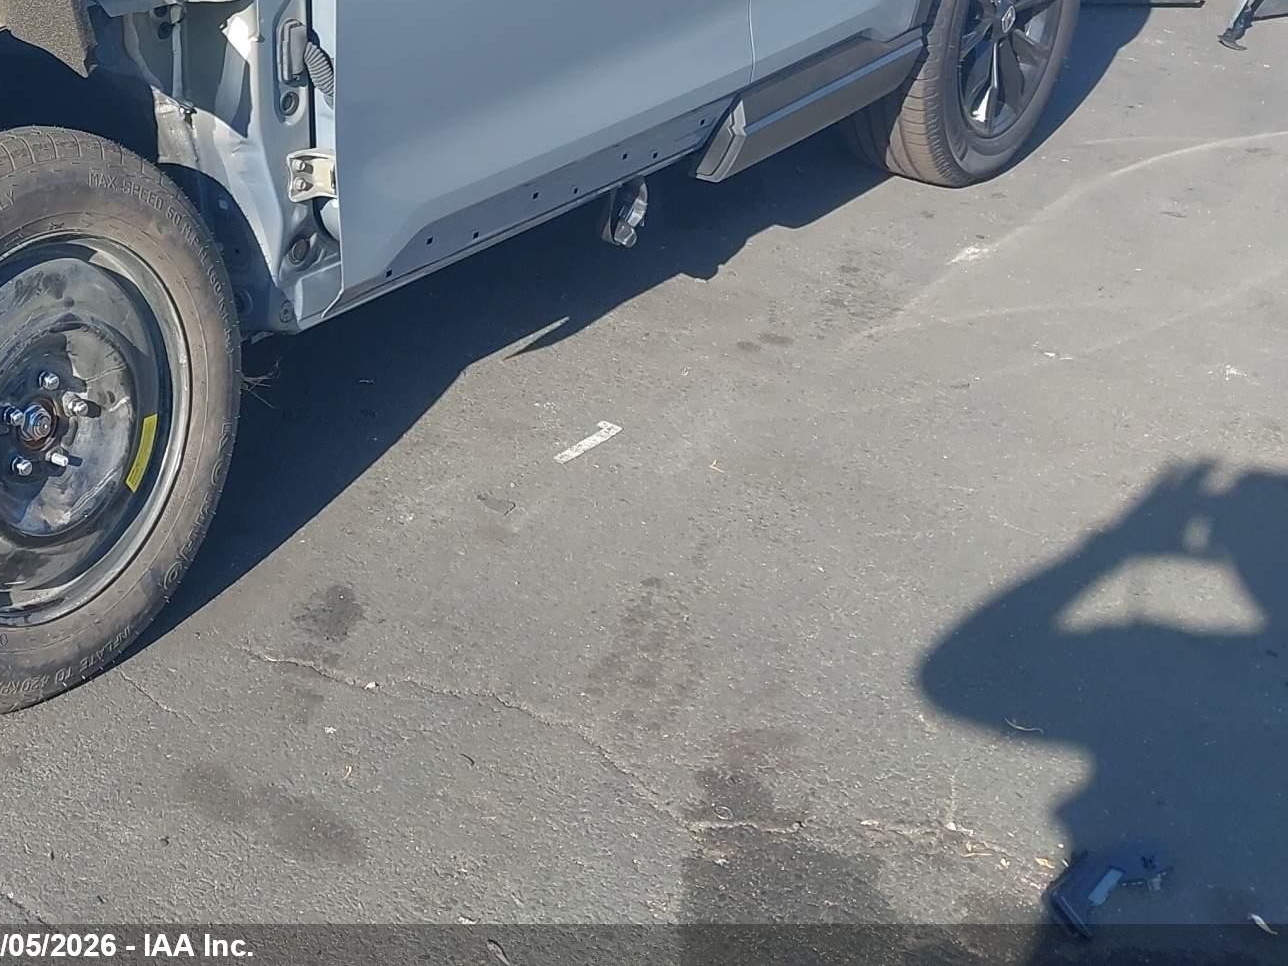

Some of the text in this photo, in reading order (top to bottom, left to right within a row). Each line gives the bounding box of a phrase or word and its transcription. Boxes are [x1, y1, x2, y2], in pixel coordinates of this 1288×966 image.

[121, 179, 164, 211] SPEED
[79, 624, 132, 673] INFLATE
[55, 666, 75, 685] TO
